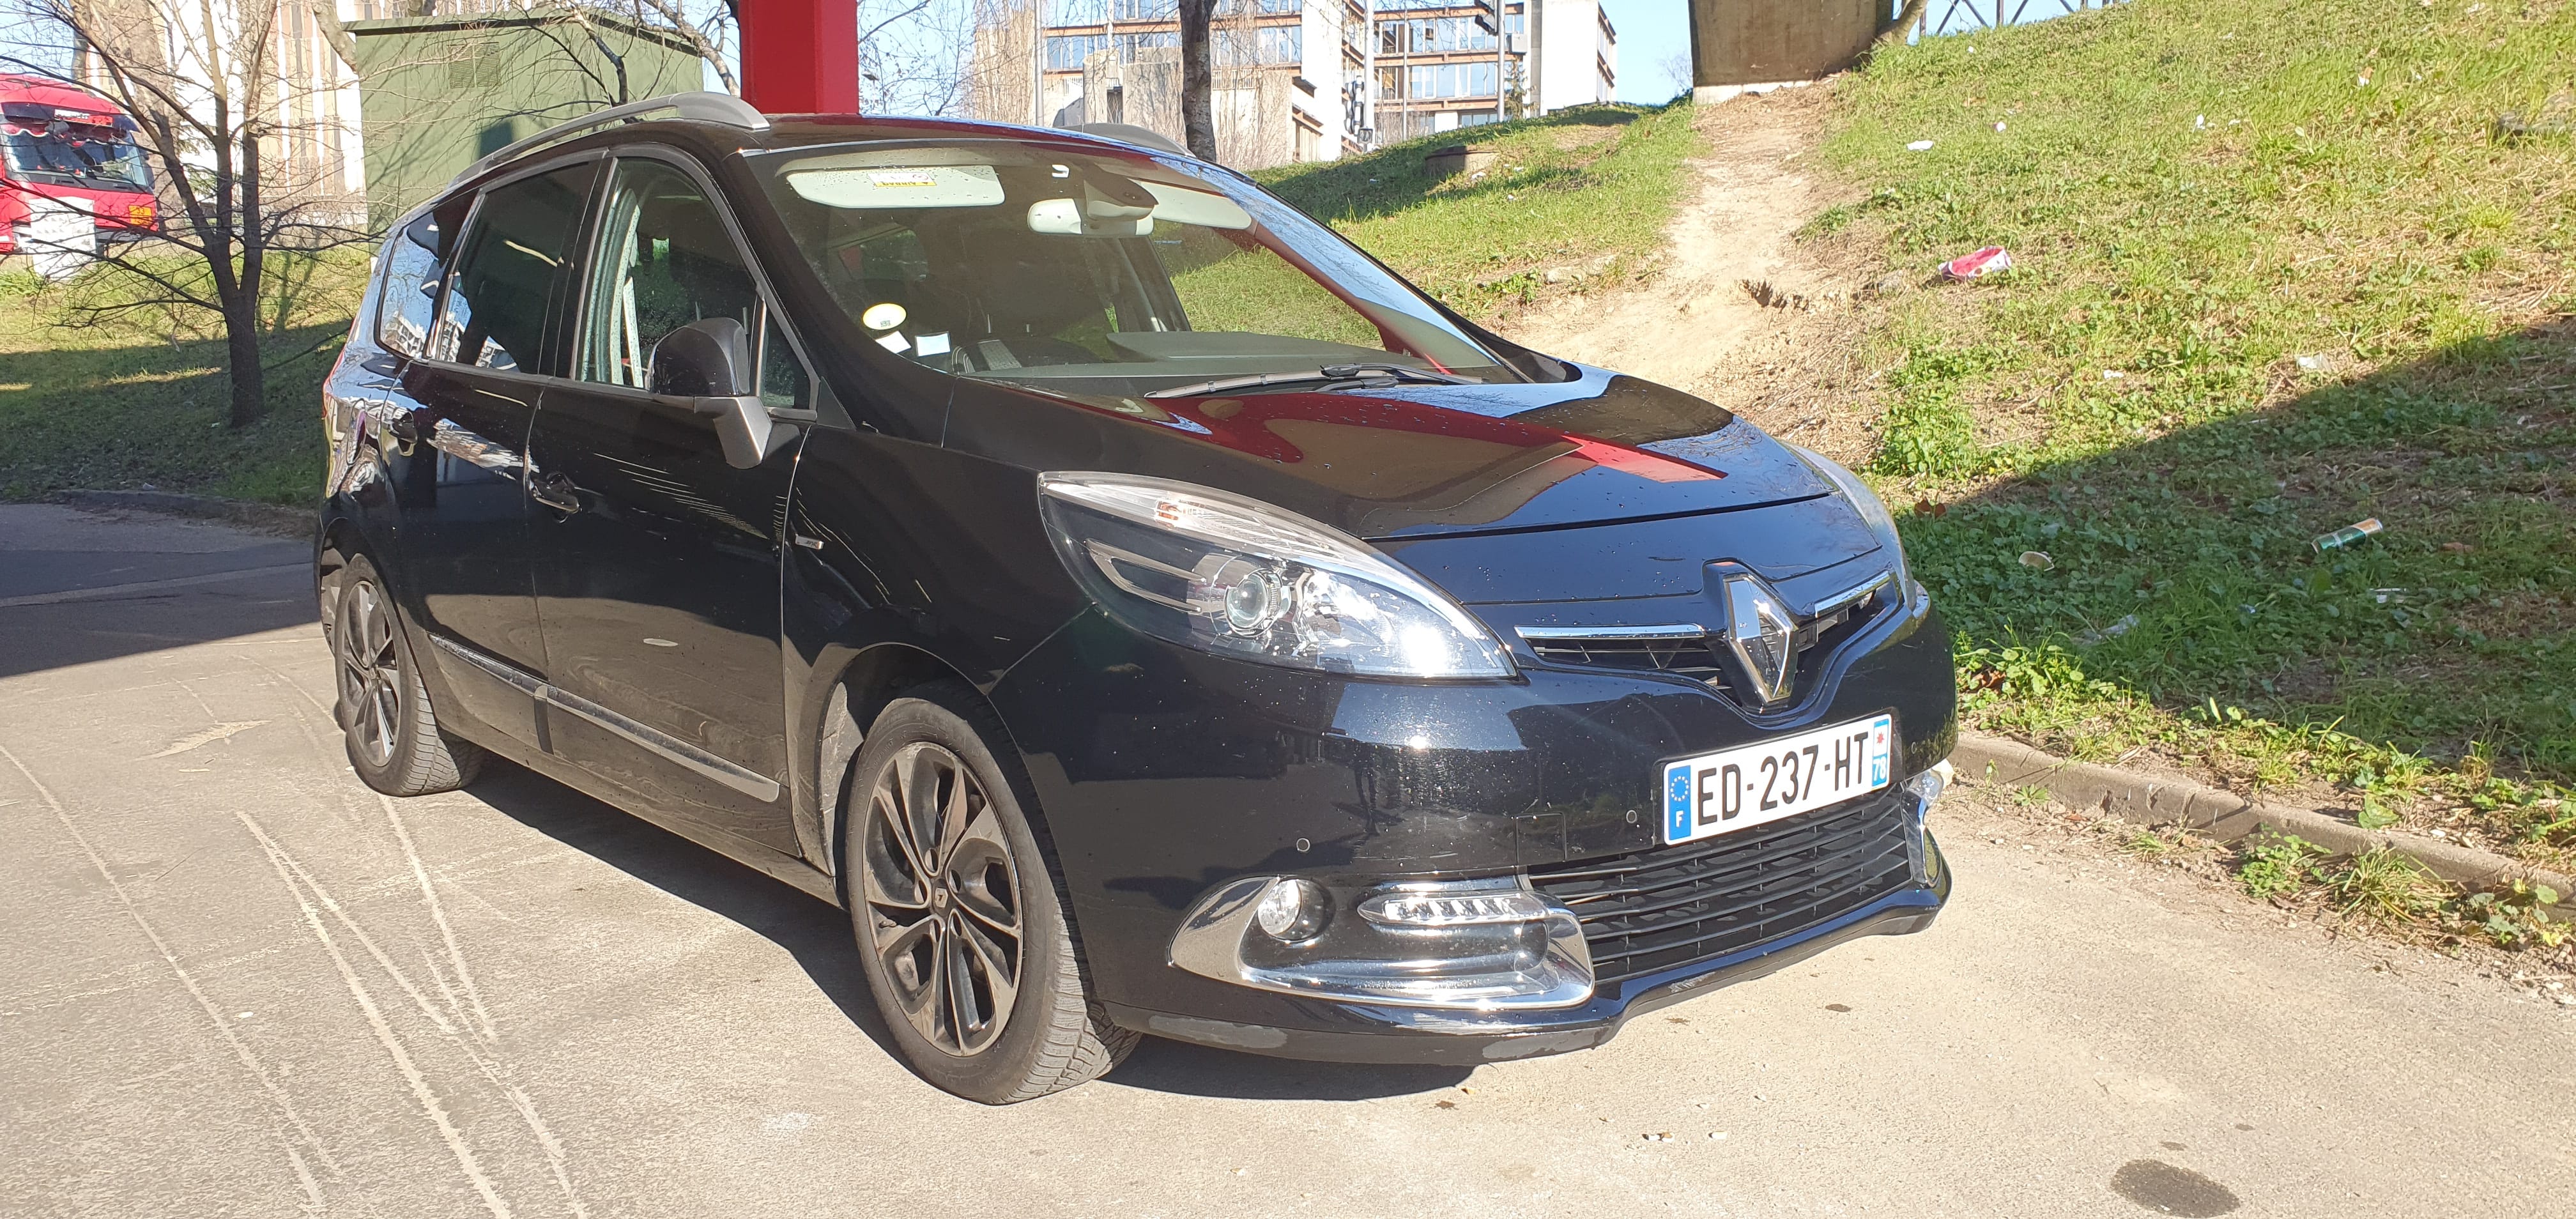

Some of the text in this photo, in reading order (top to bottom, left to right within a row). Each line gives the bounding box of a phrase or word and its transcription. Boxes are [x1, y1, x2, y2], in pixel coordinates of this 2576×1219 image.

[1697, 732, 1869, 827] ED-237-HT
[1873, 757, 1888, 782] 78
[1675, 810, 1684, 828] F
